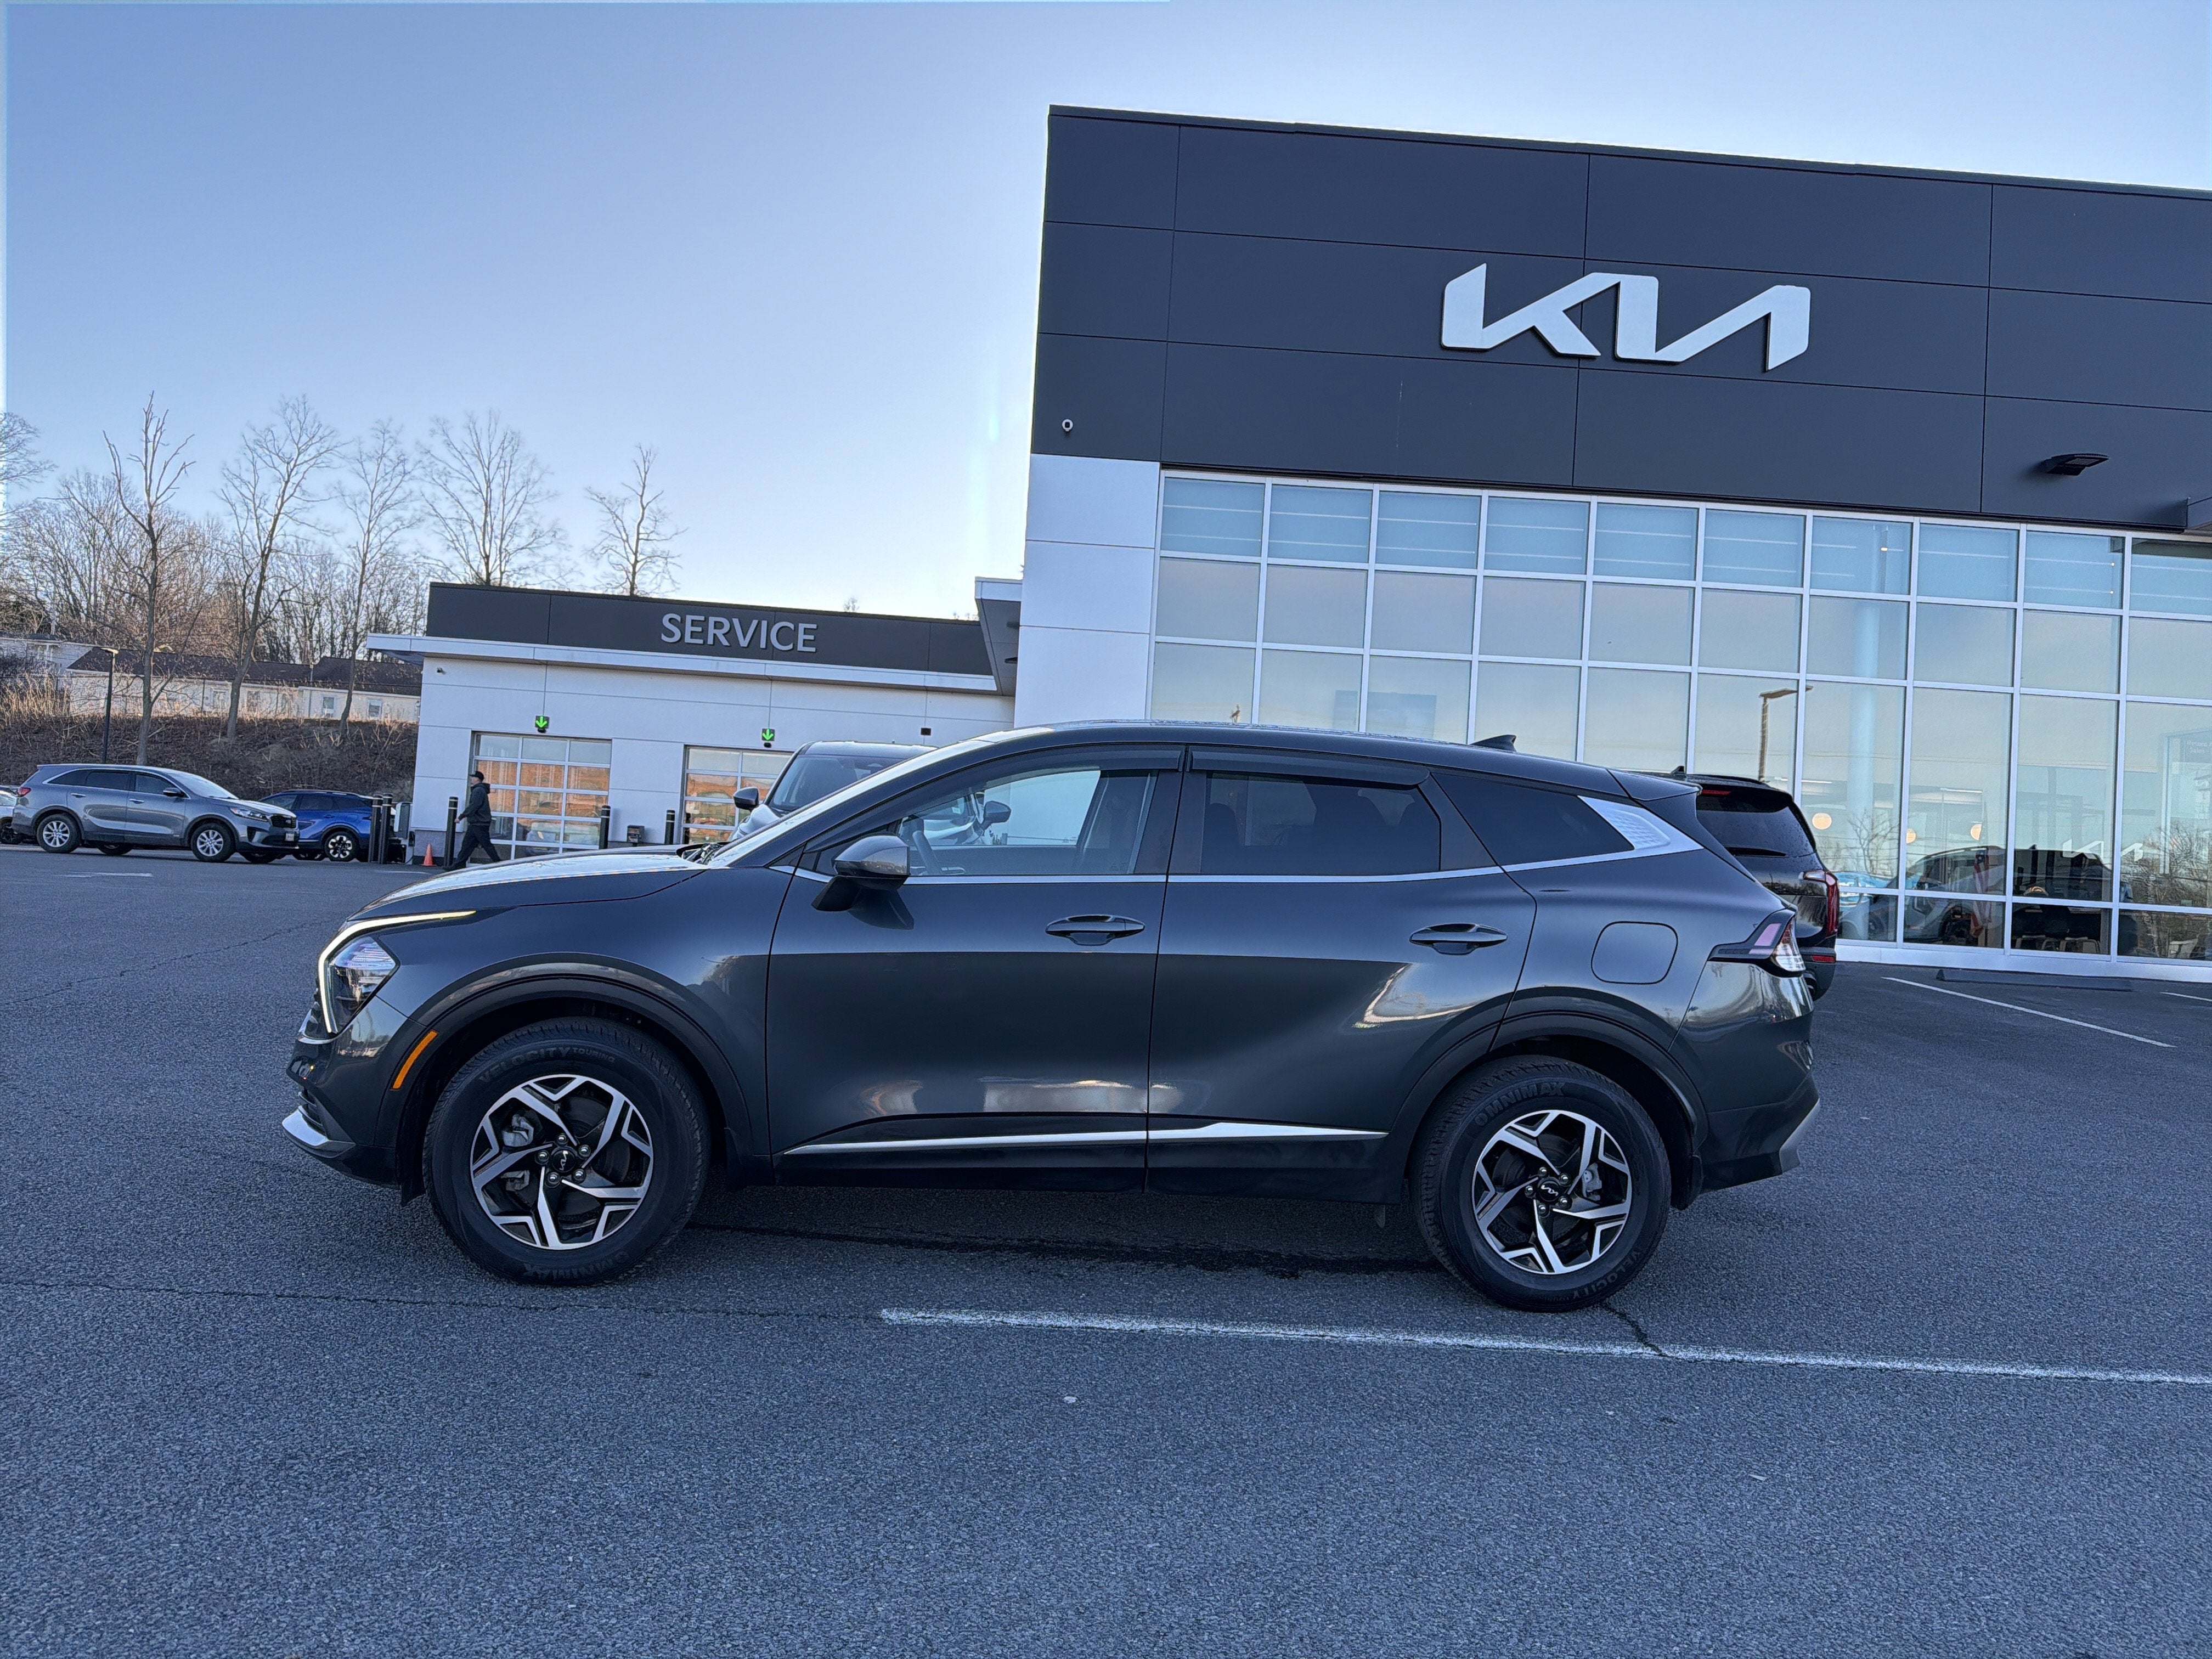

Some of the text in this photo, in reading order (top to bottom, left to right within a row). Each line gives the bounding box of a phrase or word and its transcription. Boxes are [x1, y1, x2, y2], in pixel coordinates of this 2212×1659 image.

[1442, 263, 1810, 371] KIA
[661, 613, 817, 652] SERVICE
[479, 1046, 615, 1083] VELOCITY TOURING
[1474, 1081, 1566, 1126] OMNIMAX
